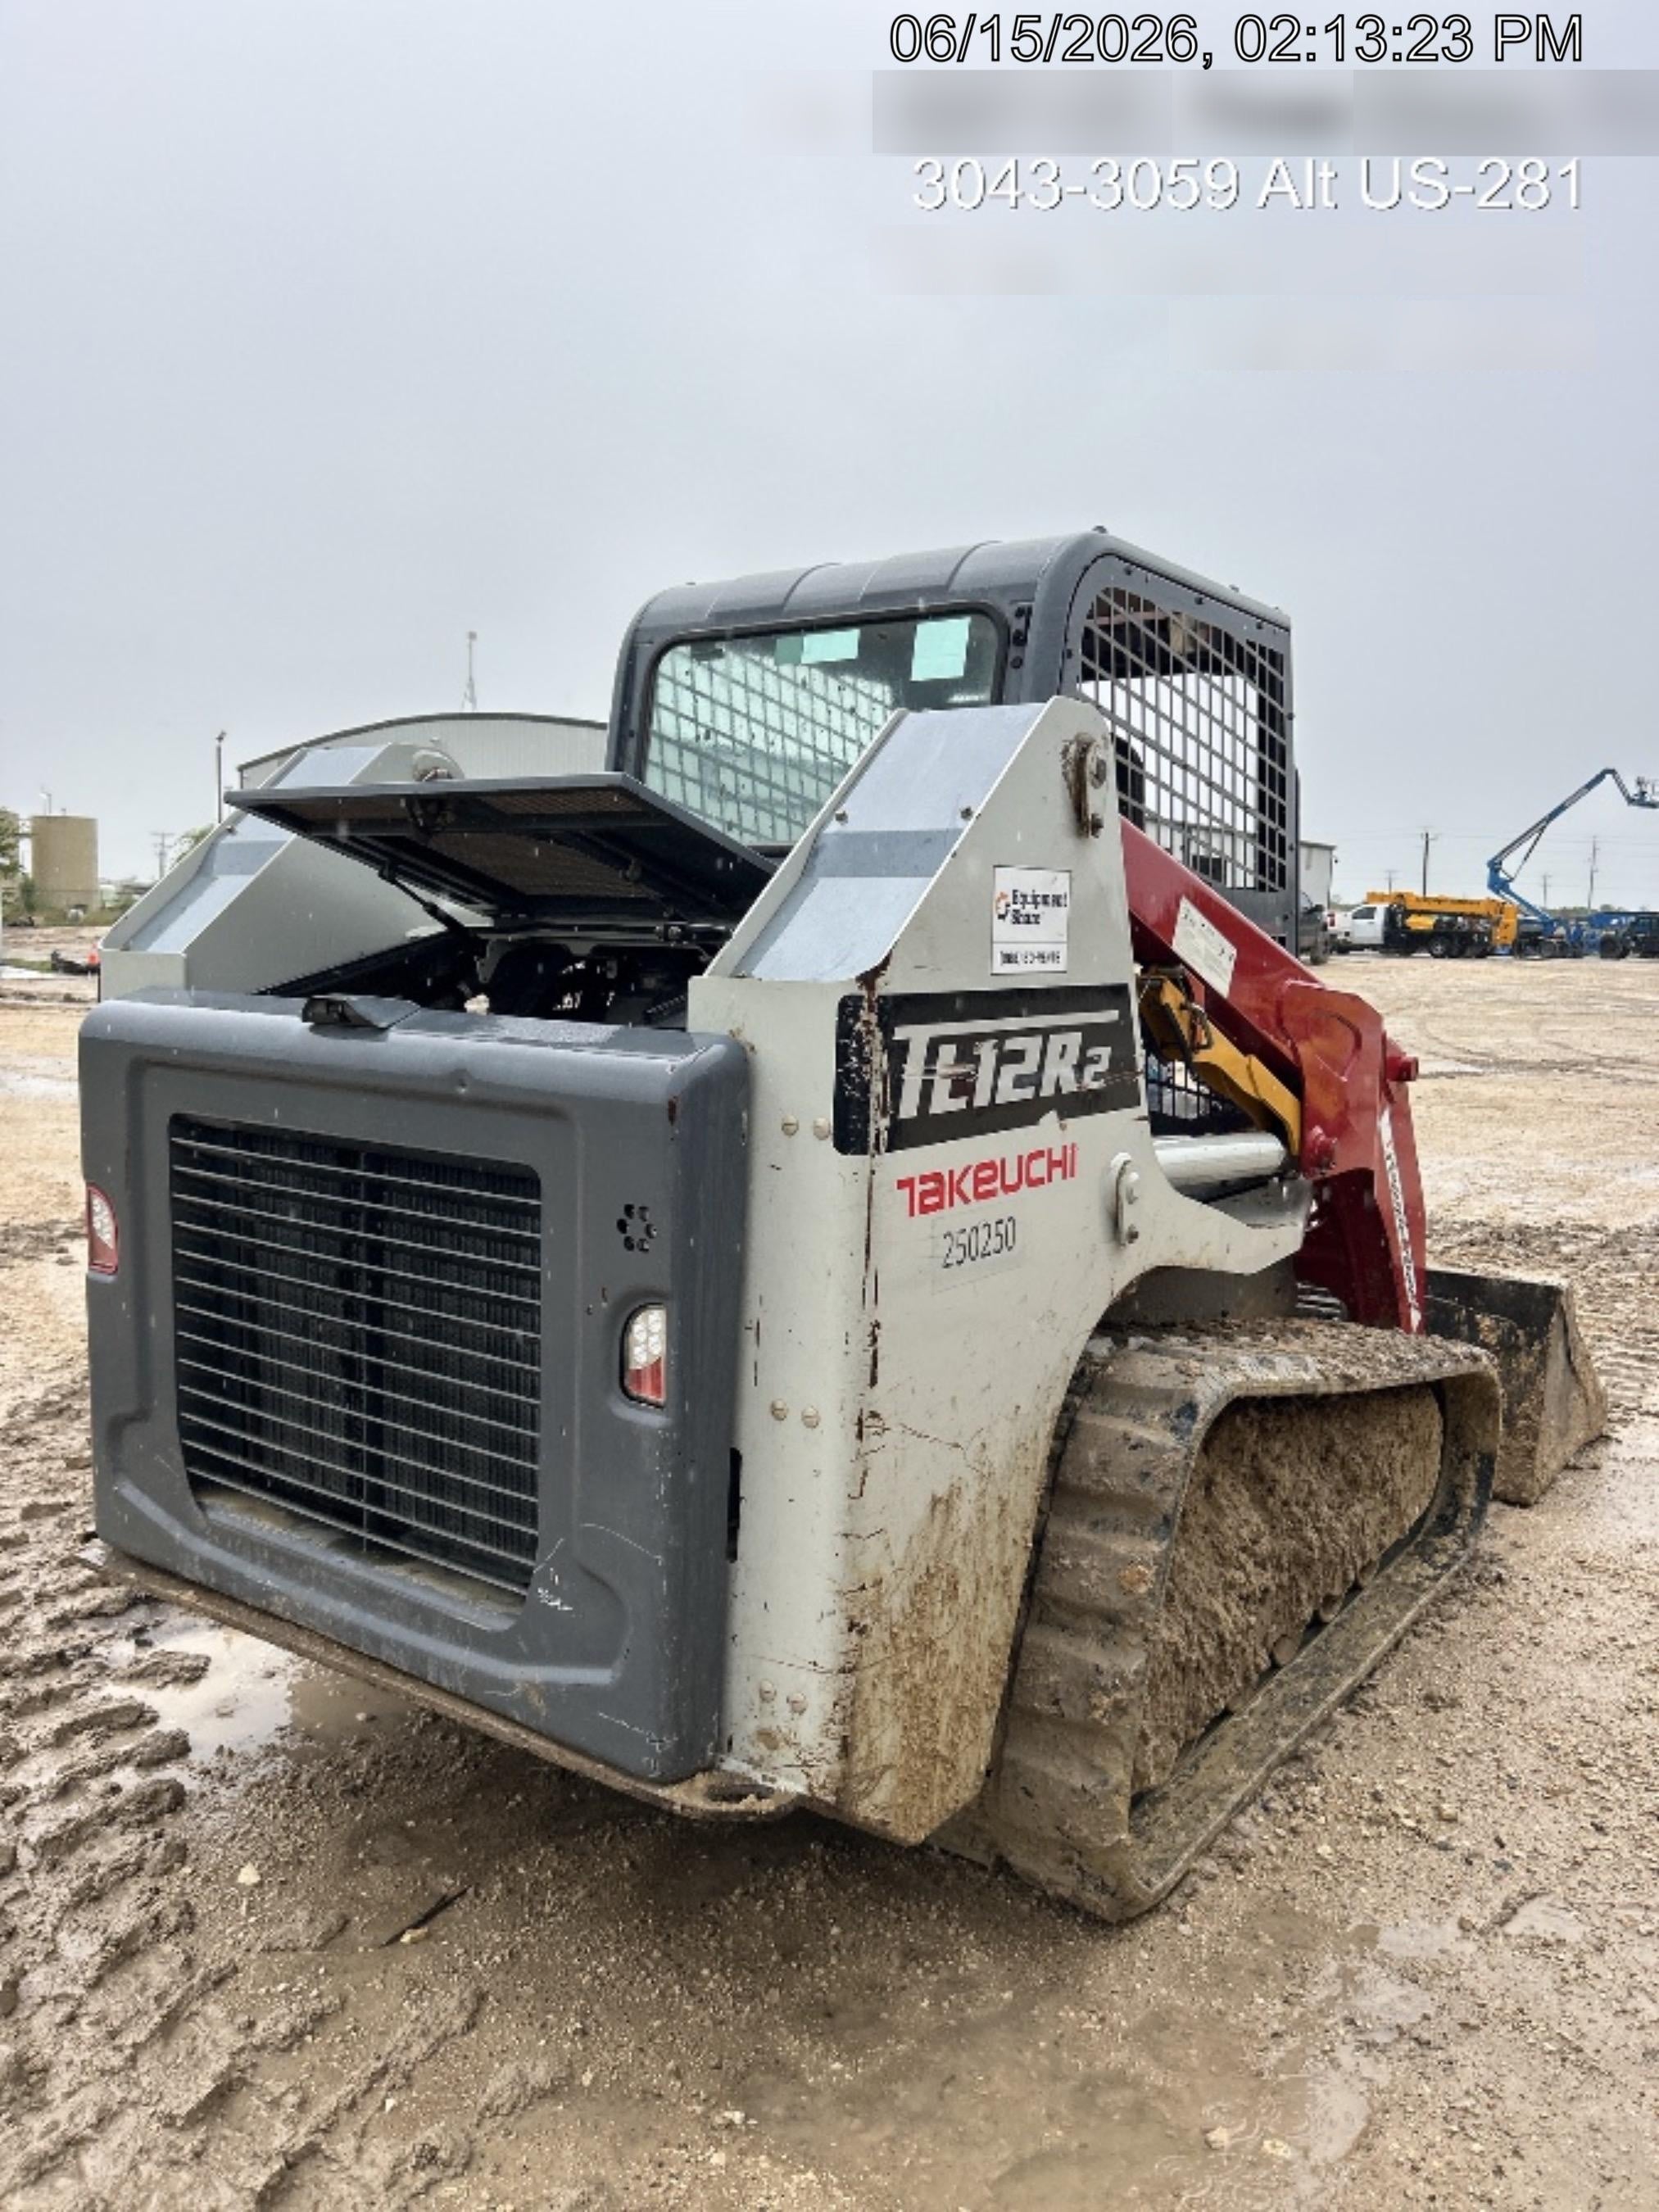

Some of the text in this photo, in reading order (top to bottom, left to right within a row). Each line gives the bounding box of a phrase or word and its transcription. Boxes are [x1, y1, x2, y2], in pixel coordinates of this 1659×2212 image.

[892, 1009, 1119, 1119] TL12R2
[896, 1142, 1079, 1217] TAKEUCHI
[941, 1216, 1017, 1269] 250250
